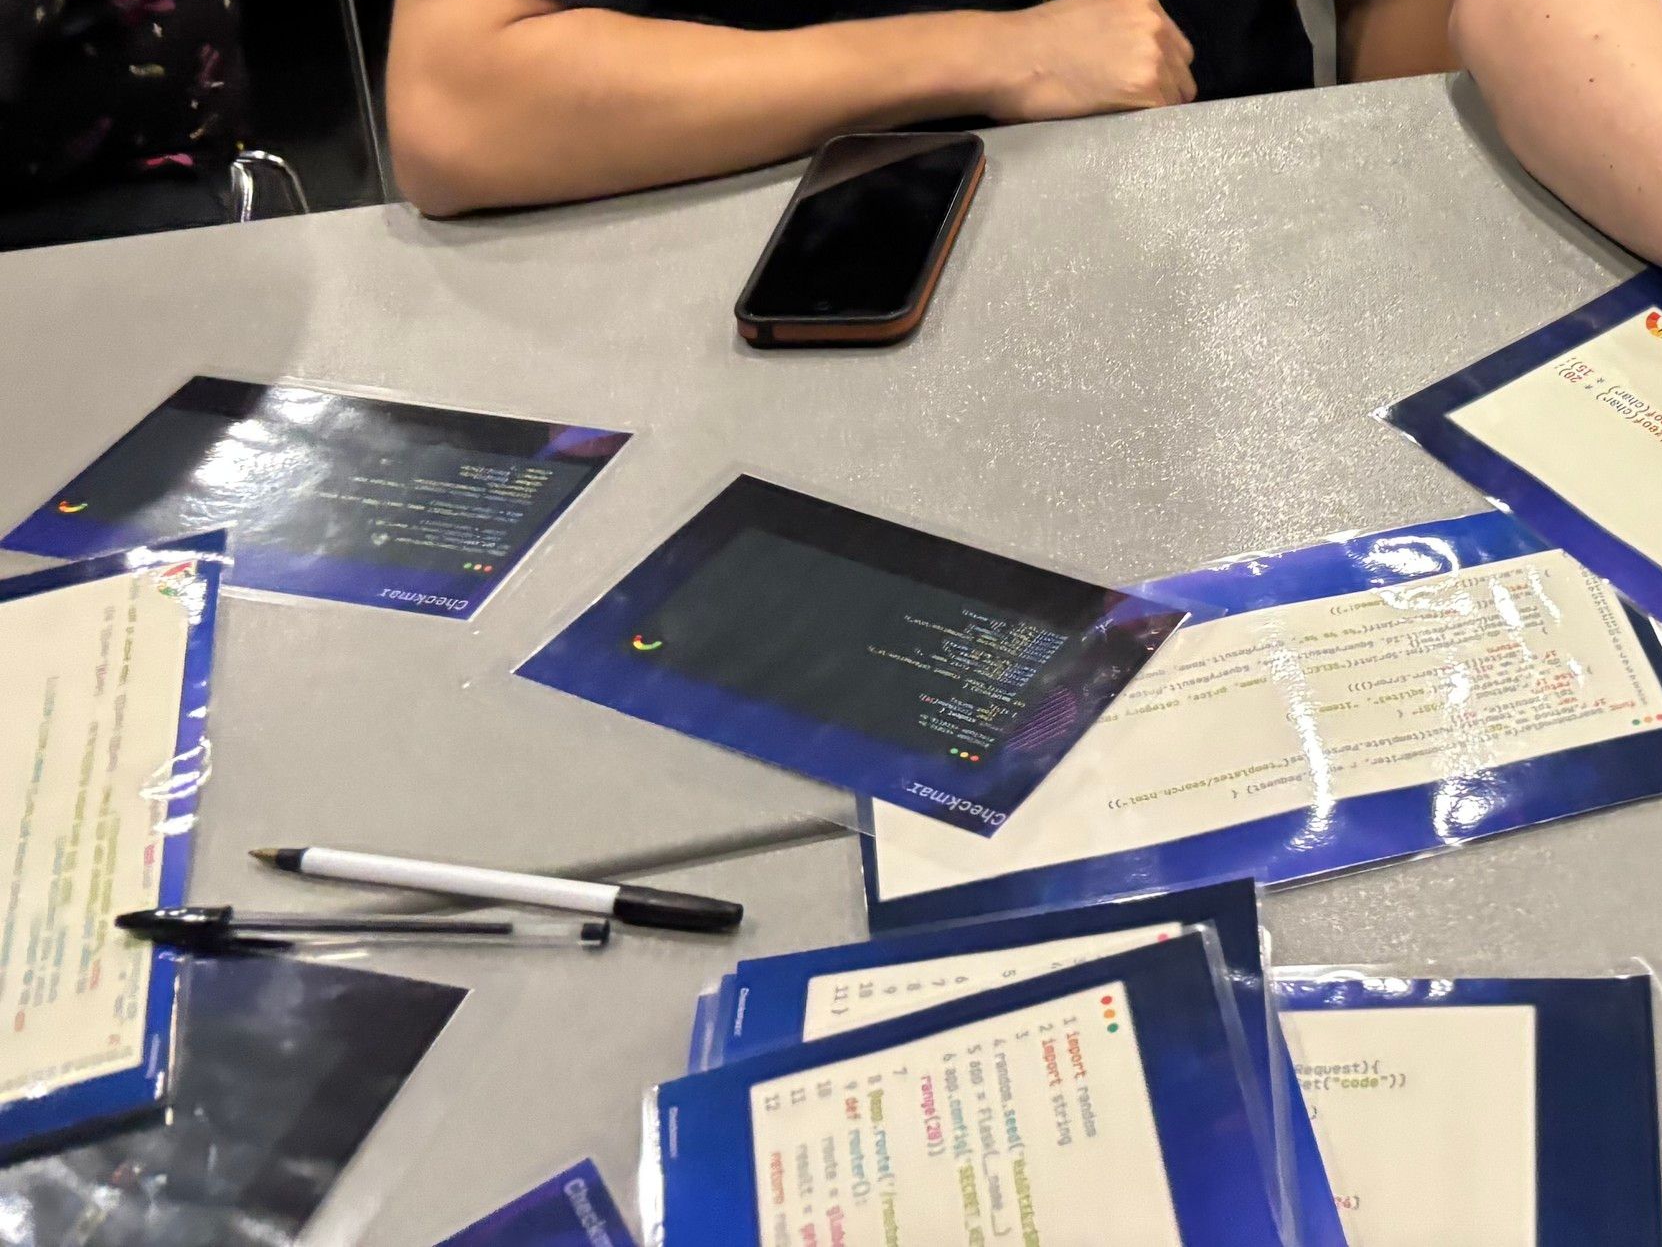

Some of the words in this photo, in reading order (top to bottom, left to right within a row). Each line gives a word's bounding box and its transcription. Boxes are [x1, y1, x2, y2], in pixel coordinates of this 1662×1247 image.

[1041, 1037, 1063, 1087] import
[1066, 1030, 1087, 1080] import
[845, 1096, 861, 1121] def
[1051, 1093, 1073, 1147] string
[1076, 1085, 1097, 1138] random
